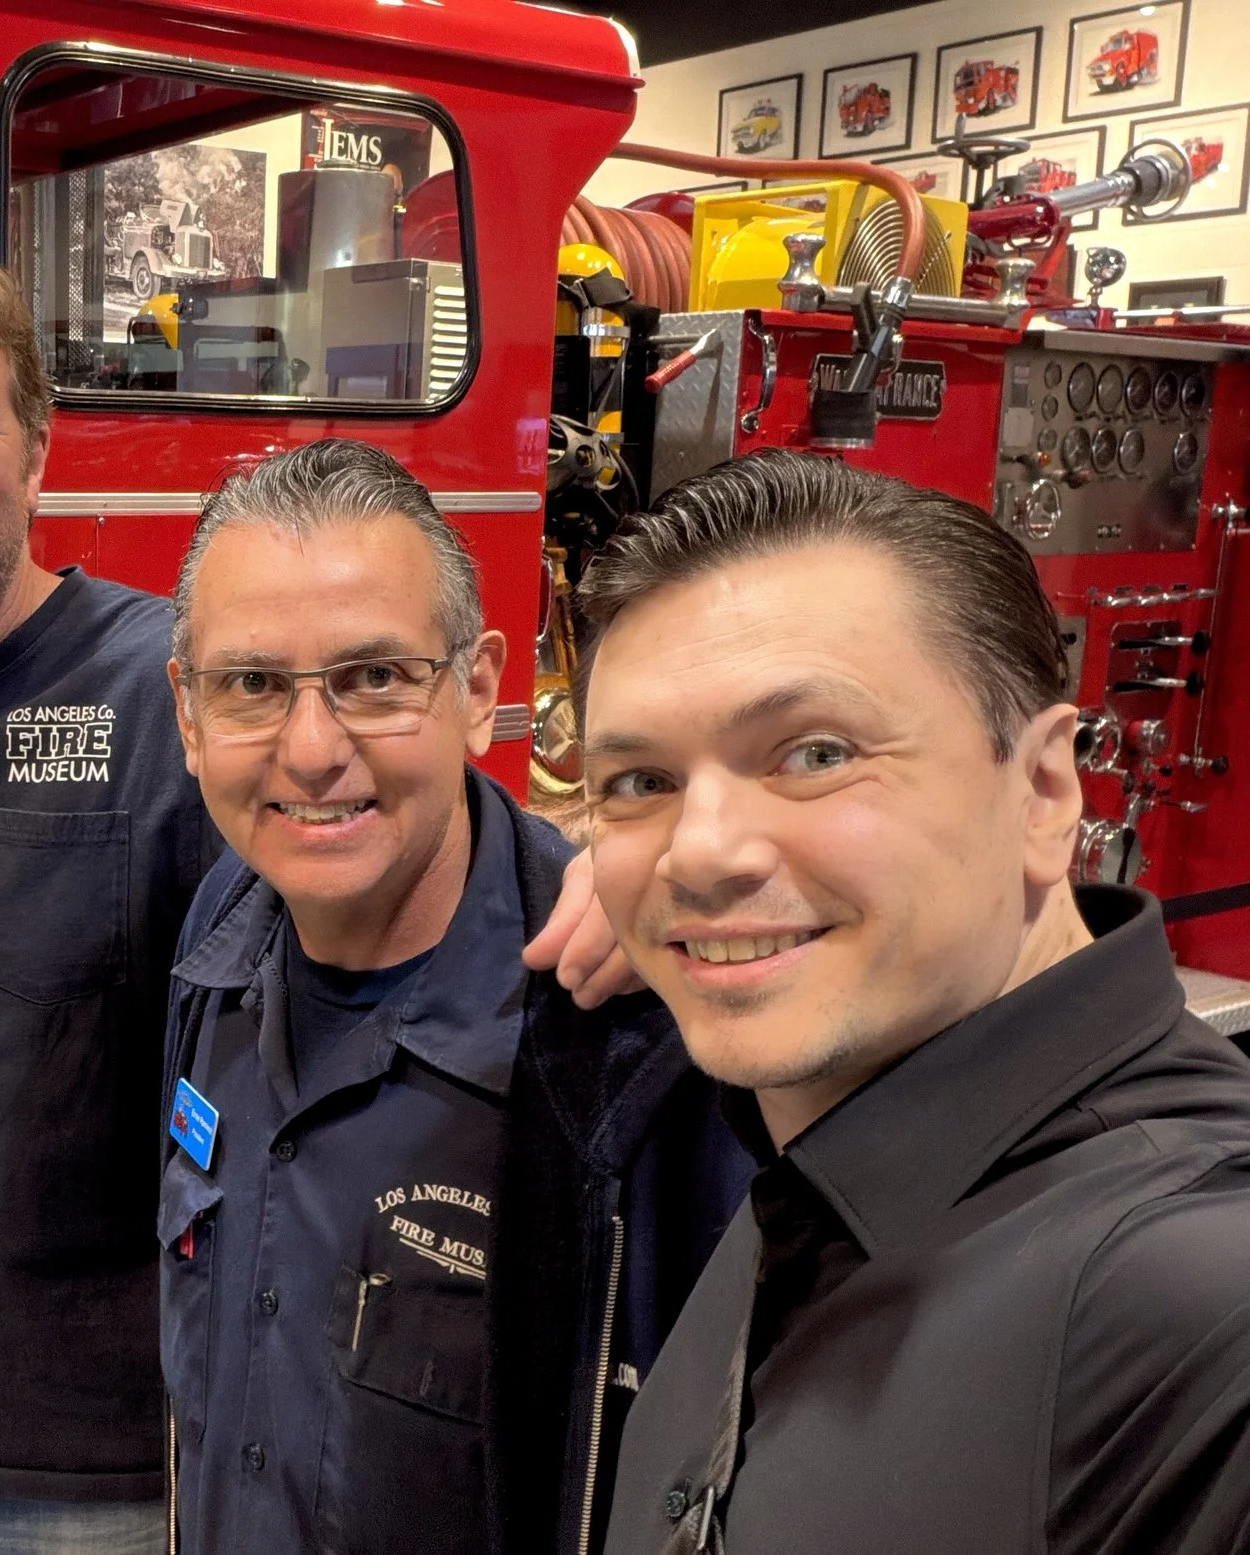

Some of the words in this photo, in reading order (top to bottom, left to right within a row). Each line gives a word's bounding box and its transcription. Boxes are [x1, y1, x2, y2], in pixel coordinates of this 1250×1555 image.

[7, 707, 32, 722] LOS
[35, 706, 97, 722] ANGELES
[97, 704, 117, 720] Co.
[6, 722, 112, 759] FIRE
[8, 761, 109, 783] MUSEUM
[375, 1187, 407, 1214] LOS
[390, 1215, 436, 1247] FIRE
